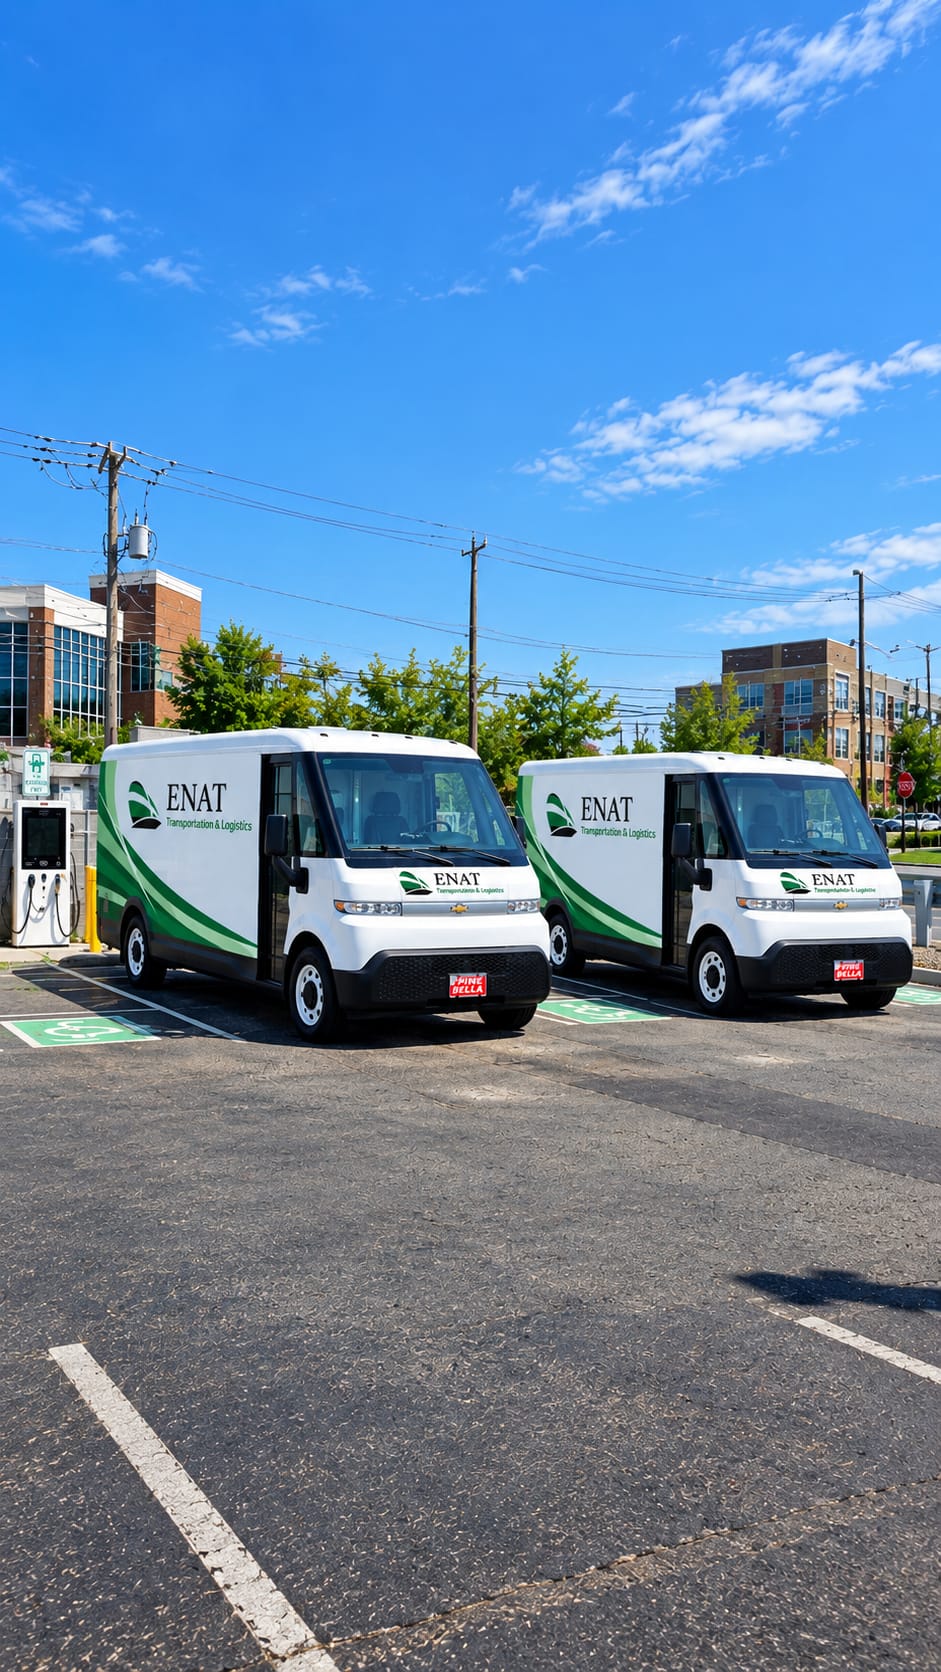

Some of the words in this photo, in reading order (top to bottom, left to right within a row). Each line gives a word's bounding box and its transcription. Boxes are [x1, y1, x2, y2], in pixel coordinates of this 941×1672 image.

[166, 783, 227, 812] ENAT
[581, 796, 633, 822] ENAT
[166, 817, 214, 830] Transportation
[214, 819, 221, 830] &
[221, 820, 253, 833] Logistics
[581, 826, 622, 837] Transportation
[622, 827, 628, 837] &
[629, 828, 656, 840] Logistics
[433, 873, 480, 886] ENAT
[811, 873, 855, 886] ENAT
